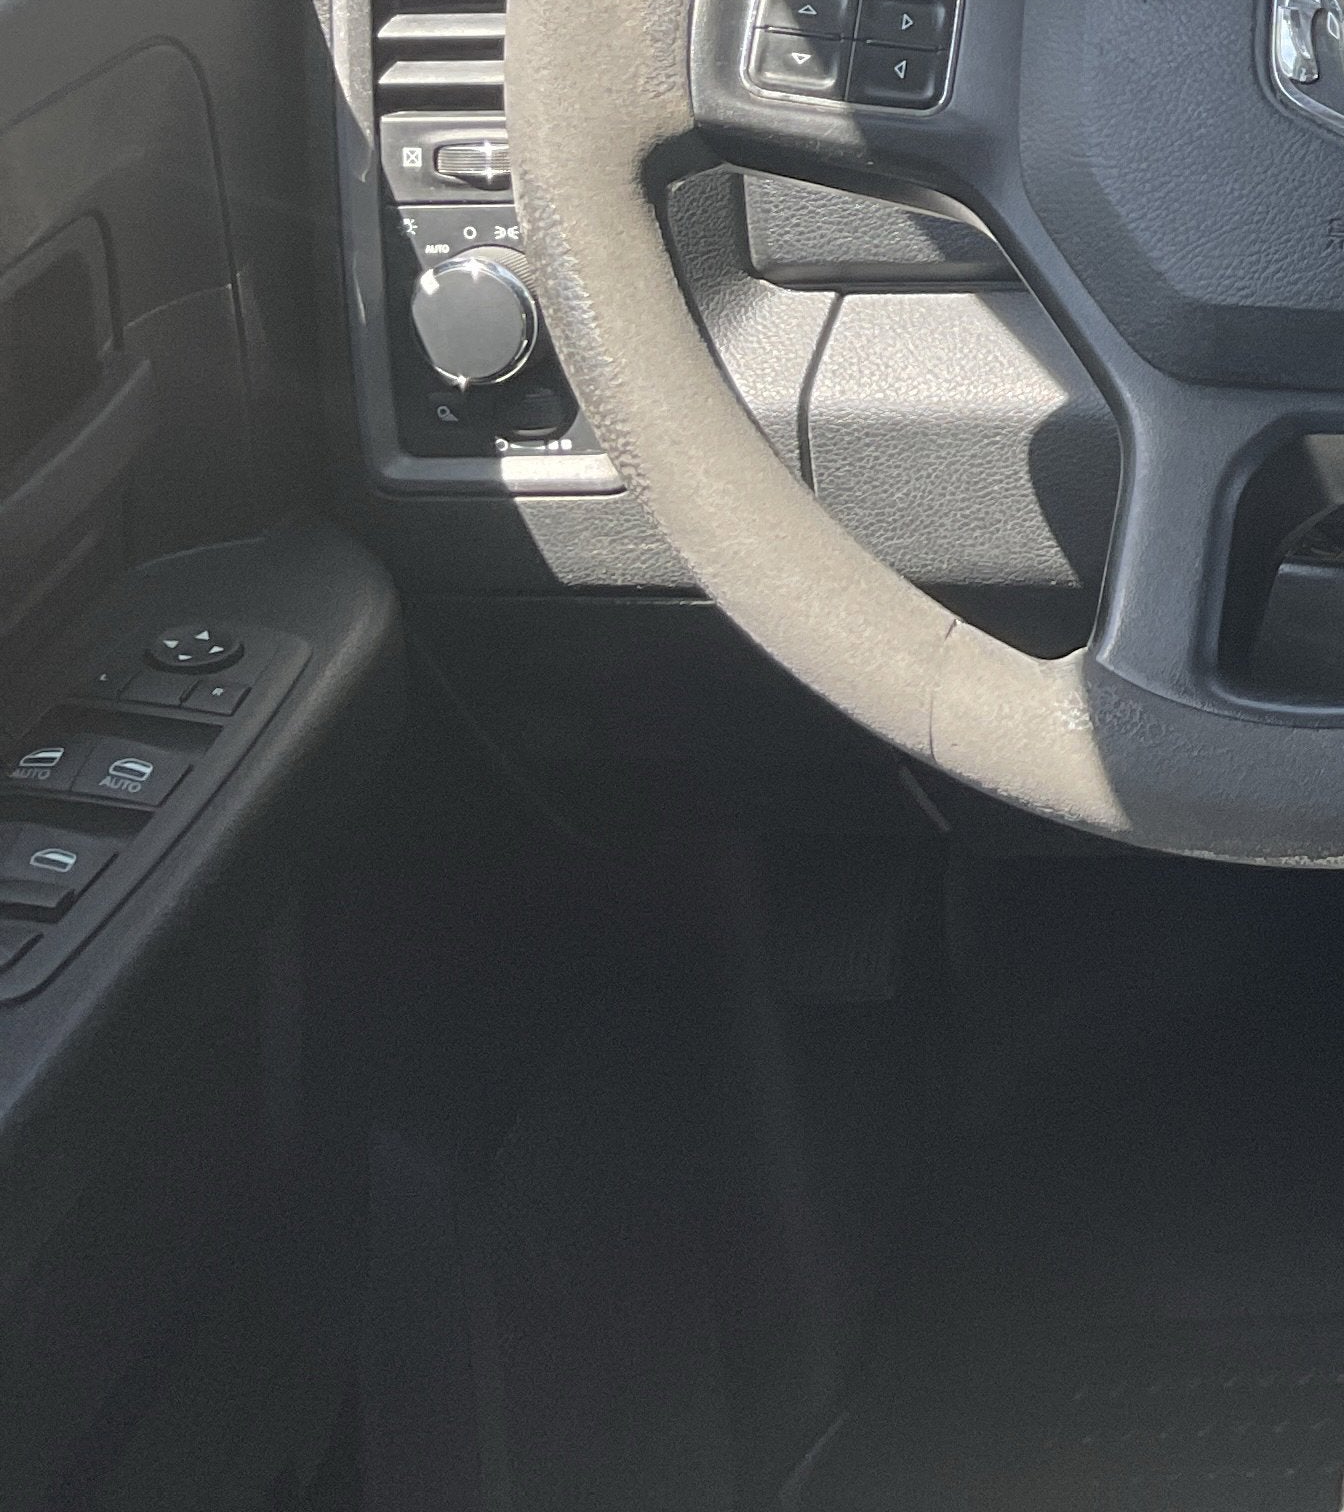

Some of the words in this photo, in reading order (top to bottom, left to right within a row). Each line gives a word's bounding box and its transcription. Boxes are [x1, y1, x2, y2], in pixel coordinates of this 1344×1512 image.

[425, 244, 450, 254] AUTO
[10, 768, 50, 780] AUTO
[98, 776, 142, 793] AUTO
